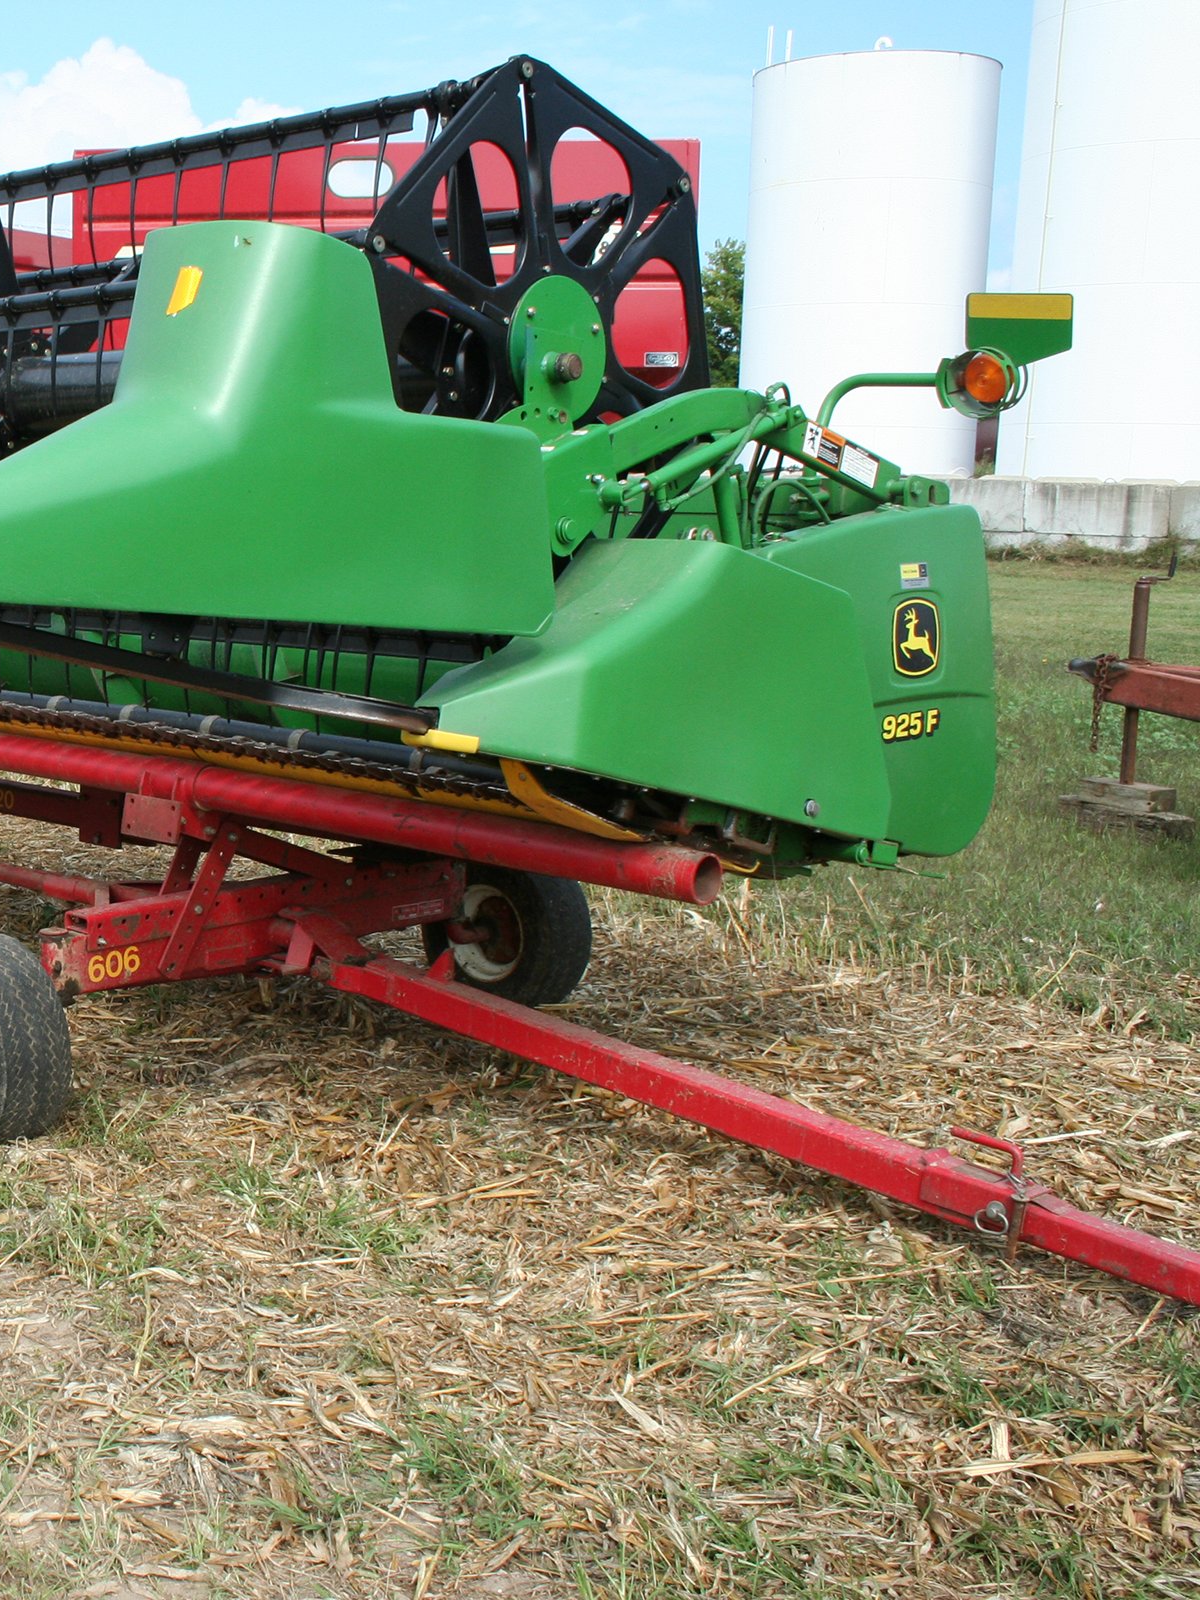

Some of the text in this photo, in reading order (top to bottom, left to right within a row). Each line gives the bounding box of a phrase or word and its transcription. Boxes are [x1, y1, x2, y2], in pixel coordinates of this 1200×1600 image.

[882, 709, 938, 741] 925 F
[88, 946, 141, 982] 606
